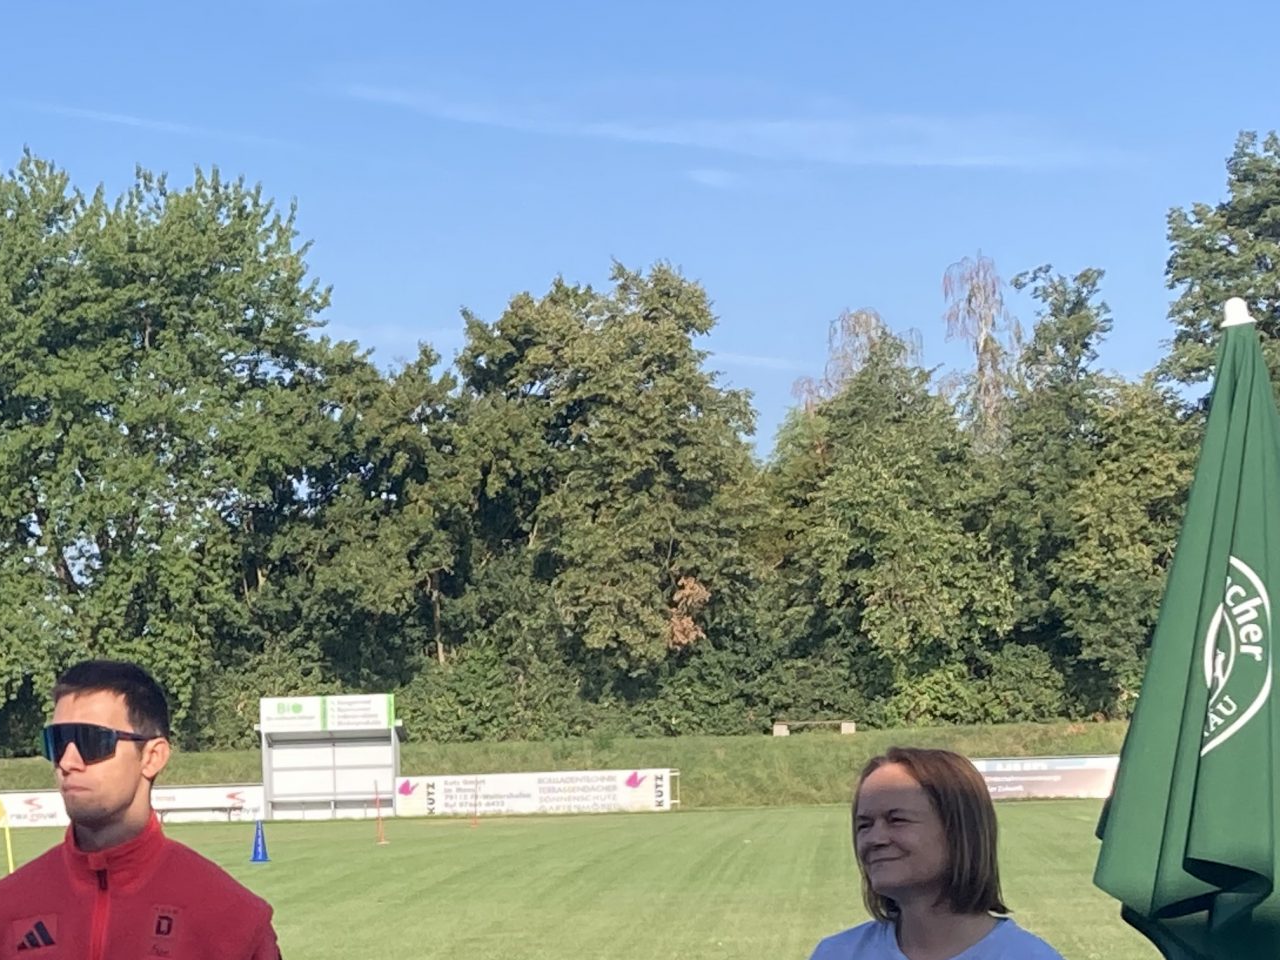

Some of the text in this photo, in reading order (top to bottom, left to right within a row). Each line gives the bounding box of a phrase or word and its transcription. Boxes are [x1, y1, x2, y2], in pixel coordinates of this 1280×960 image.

[1225, 576, 1263, 661] cher
[426, 782, 436, 815] KUTZ
[655, 774, 664, 807] KUTZ
[156, 915, 173, 936] D
